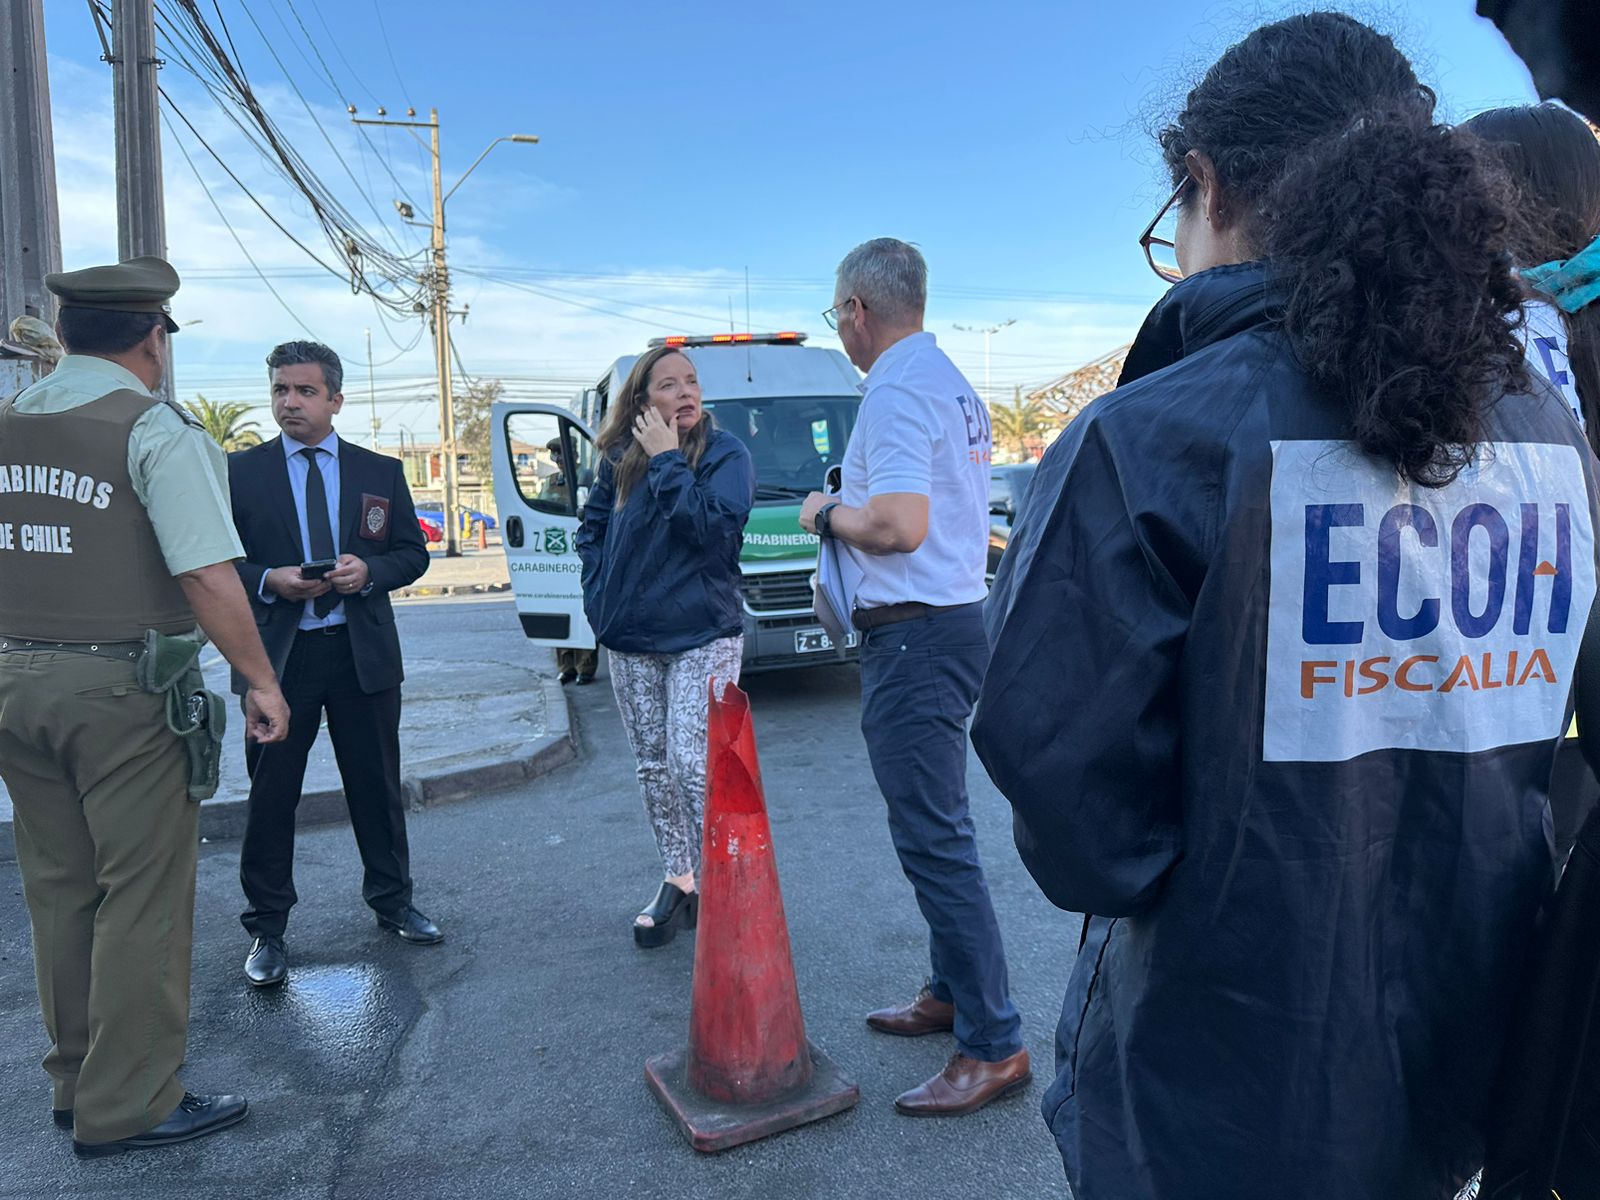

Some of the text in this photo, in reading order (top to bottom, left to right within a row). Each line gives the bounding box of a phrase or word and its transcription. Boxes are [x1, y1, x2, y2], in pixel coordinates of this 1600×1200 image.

[20, 523, 73, 554] CHILE
[533, 531, 542, 552] Z
[511, 562, 583, 573] CARABINEROS
[1302, 503, 1573, 645] ECOH
[1300, 649, 1557, 699] FISCALIA
